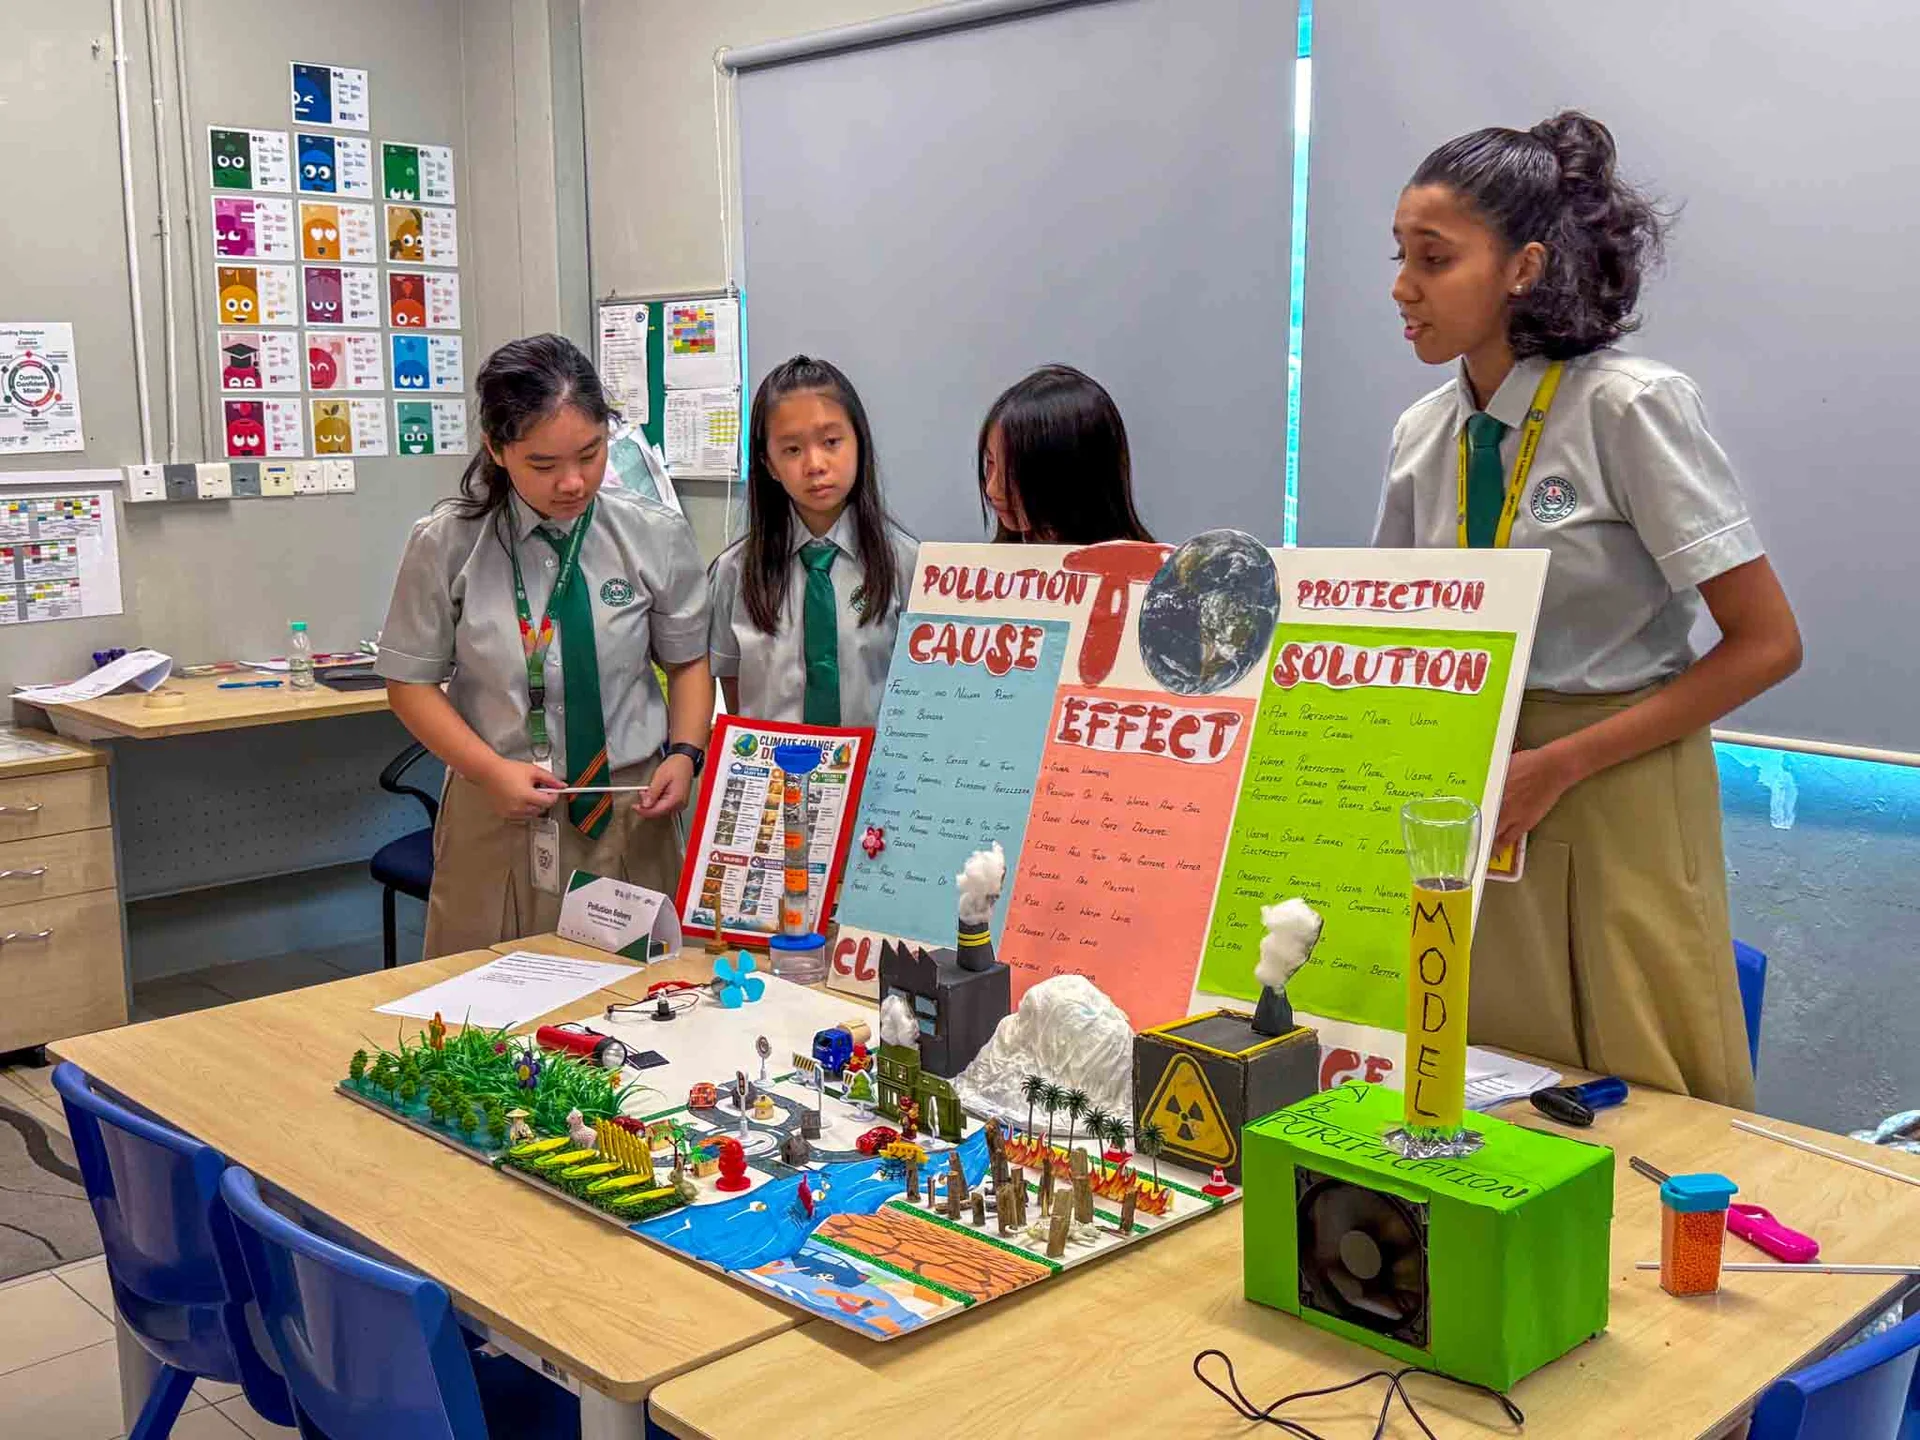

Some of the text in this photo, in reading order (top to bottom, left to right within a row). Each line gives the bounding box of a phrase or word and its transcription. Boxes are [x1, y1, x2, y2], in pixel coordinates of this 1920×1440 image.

[922, 565, 1087, 606] POLLUTION
[1297, 579, 1485, 610] PROTECTION
[909, 622, 1043, 674] CAUSE
[1273, 643, 1488, 692] SOLUTION
[1058, 697, 1240, 758] EFFECT
[1411, 901, 1456, 1118] MODEL
[1259, 1114, 1531, 1200] PURIFICATION
